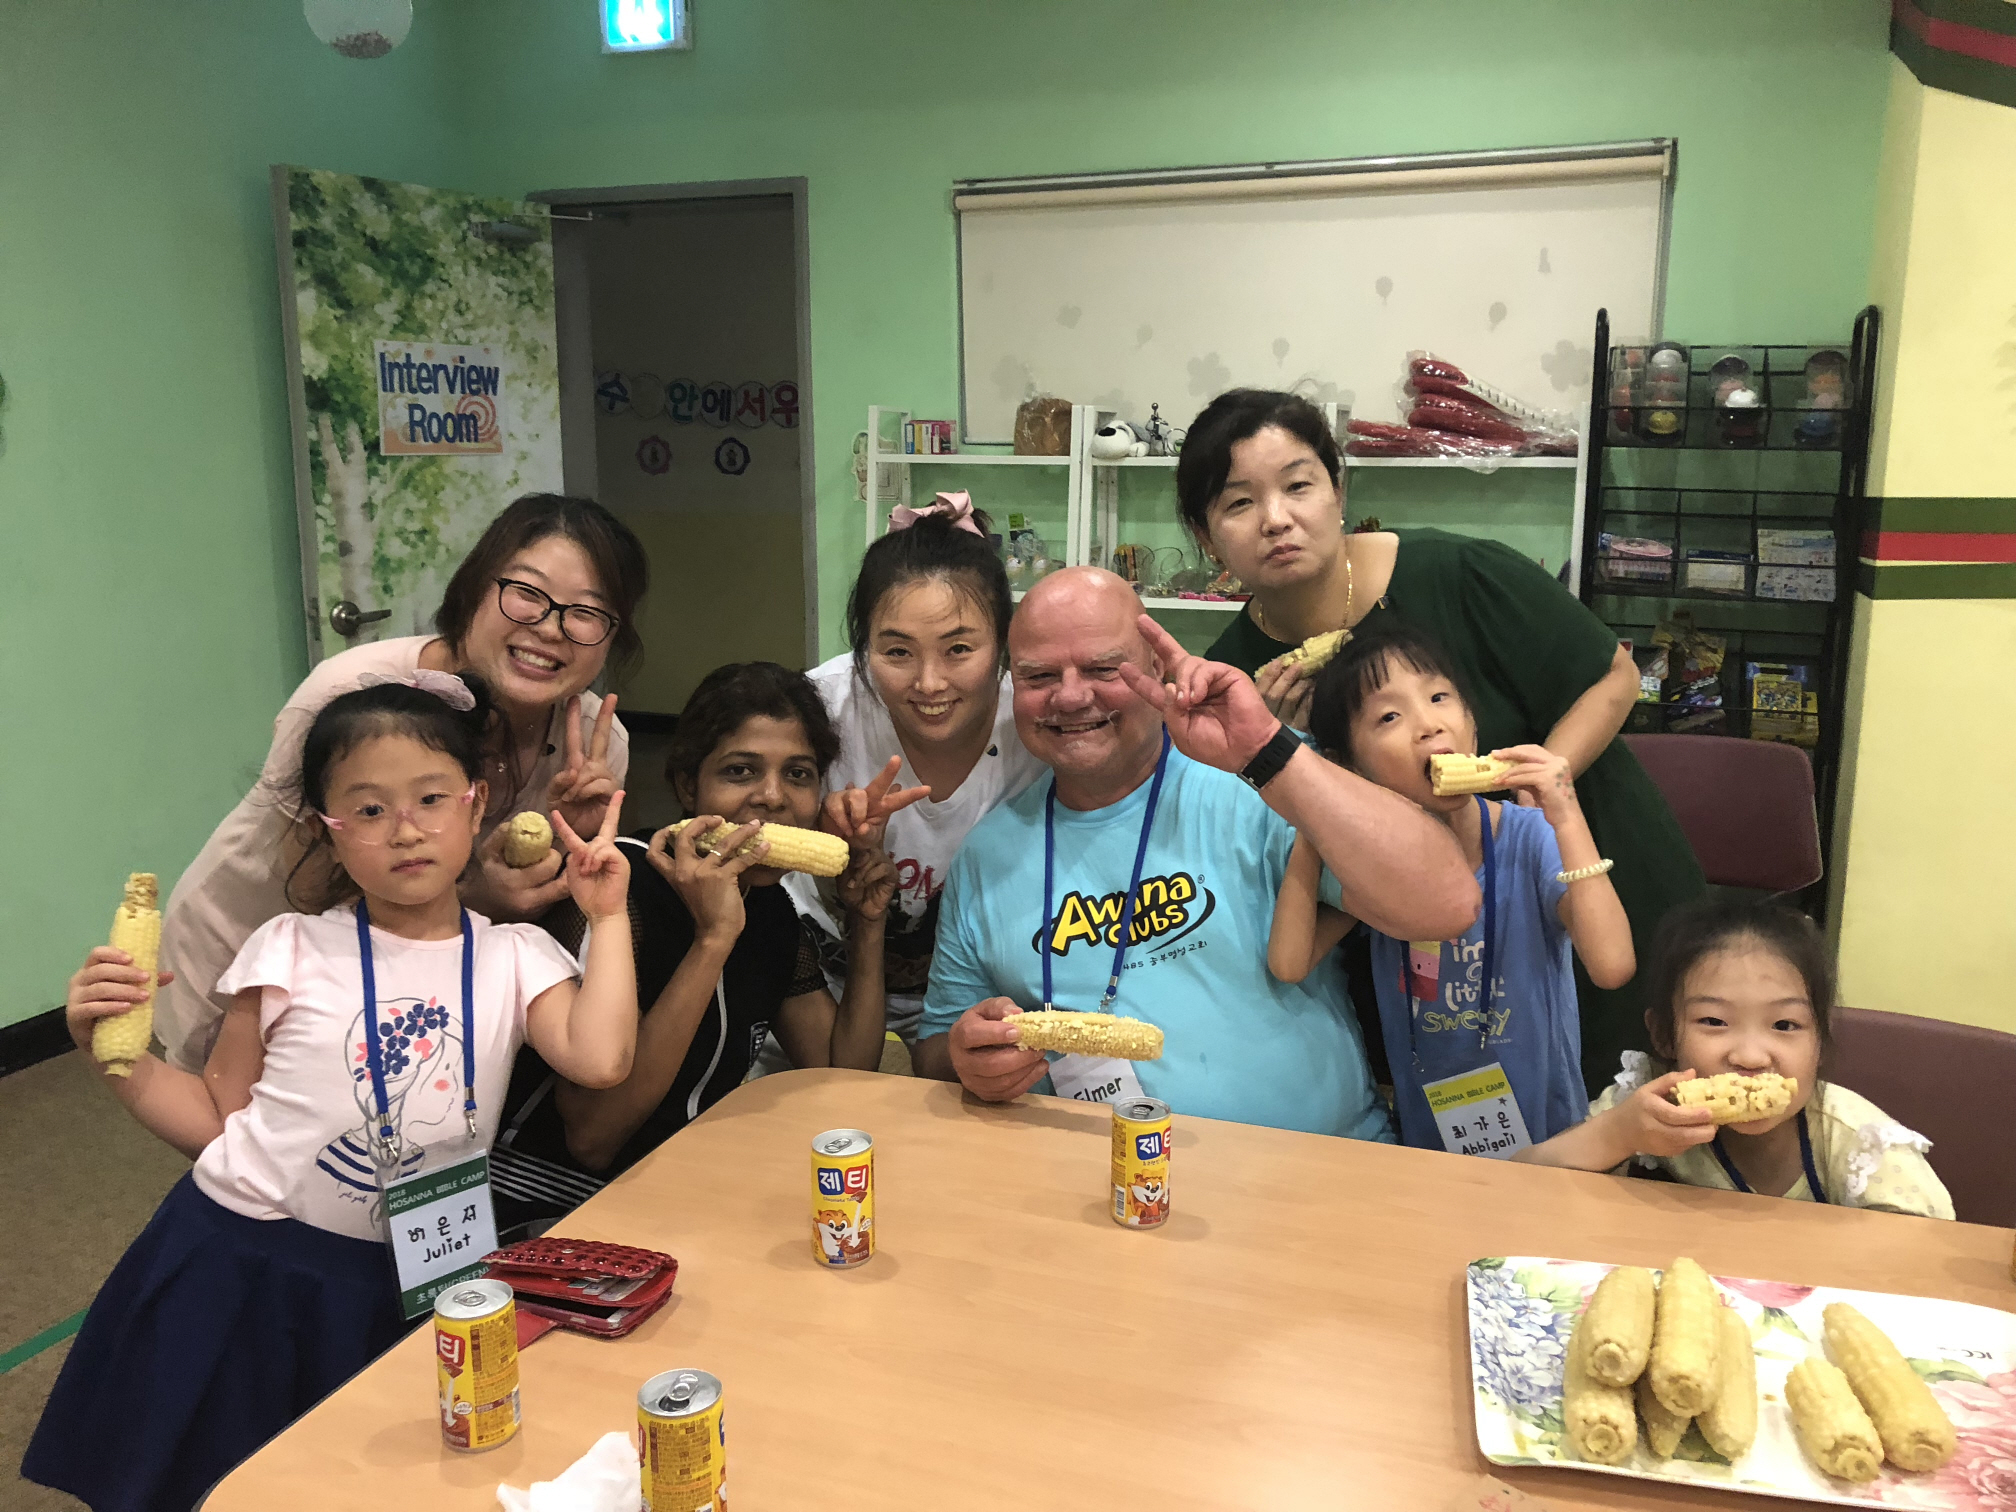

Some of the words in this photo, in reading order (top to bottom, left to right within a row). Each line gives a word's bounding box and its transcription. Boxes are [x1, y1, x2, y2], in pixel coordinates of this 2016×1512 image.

[379, 352, 500, 396] Interview
[408, 403, 480, 443] Room
[1431, 1093, 1465, 1107] HOSANNA
[1466, 1087, 1485, 1098] BIBLE
[1485, 1081, 1506, 1093] CAMP
[1462, 1132, 1516, 1156] Abbigail
[388, 1189, 434, 1211] HOSANNA
[436, 1180, 458, 1195] BIBLE
[460, 1170, 486, 1185] CAMP
[423, 1232, 471, 1263] Juliet
